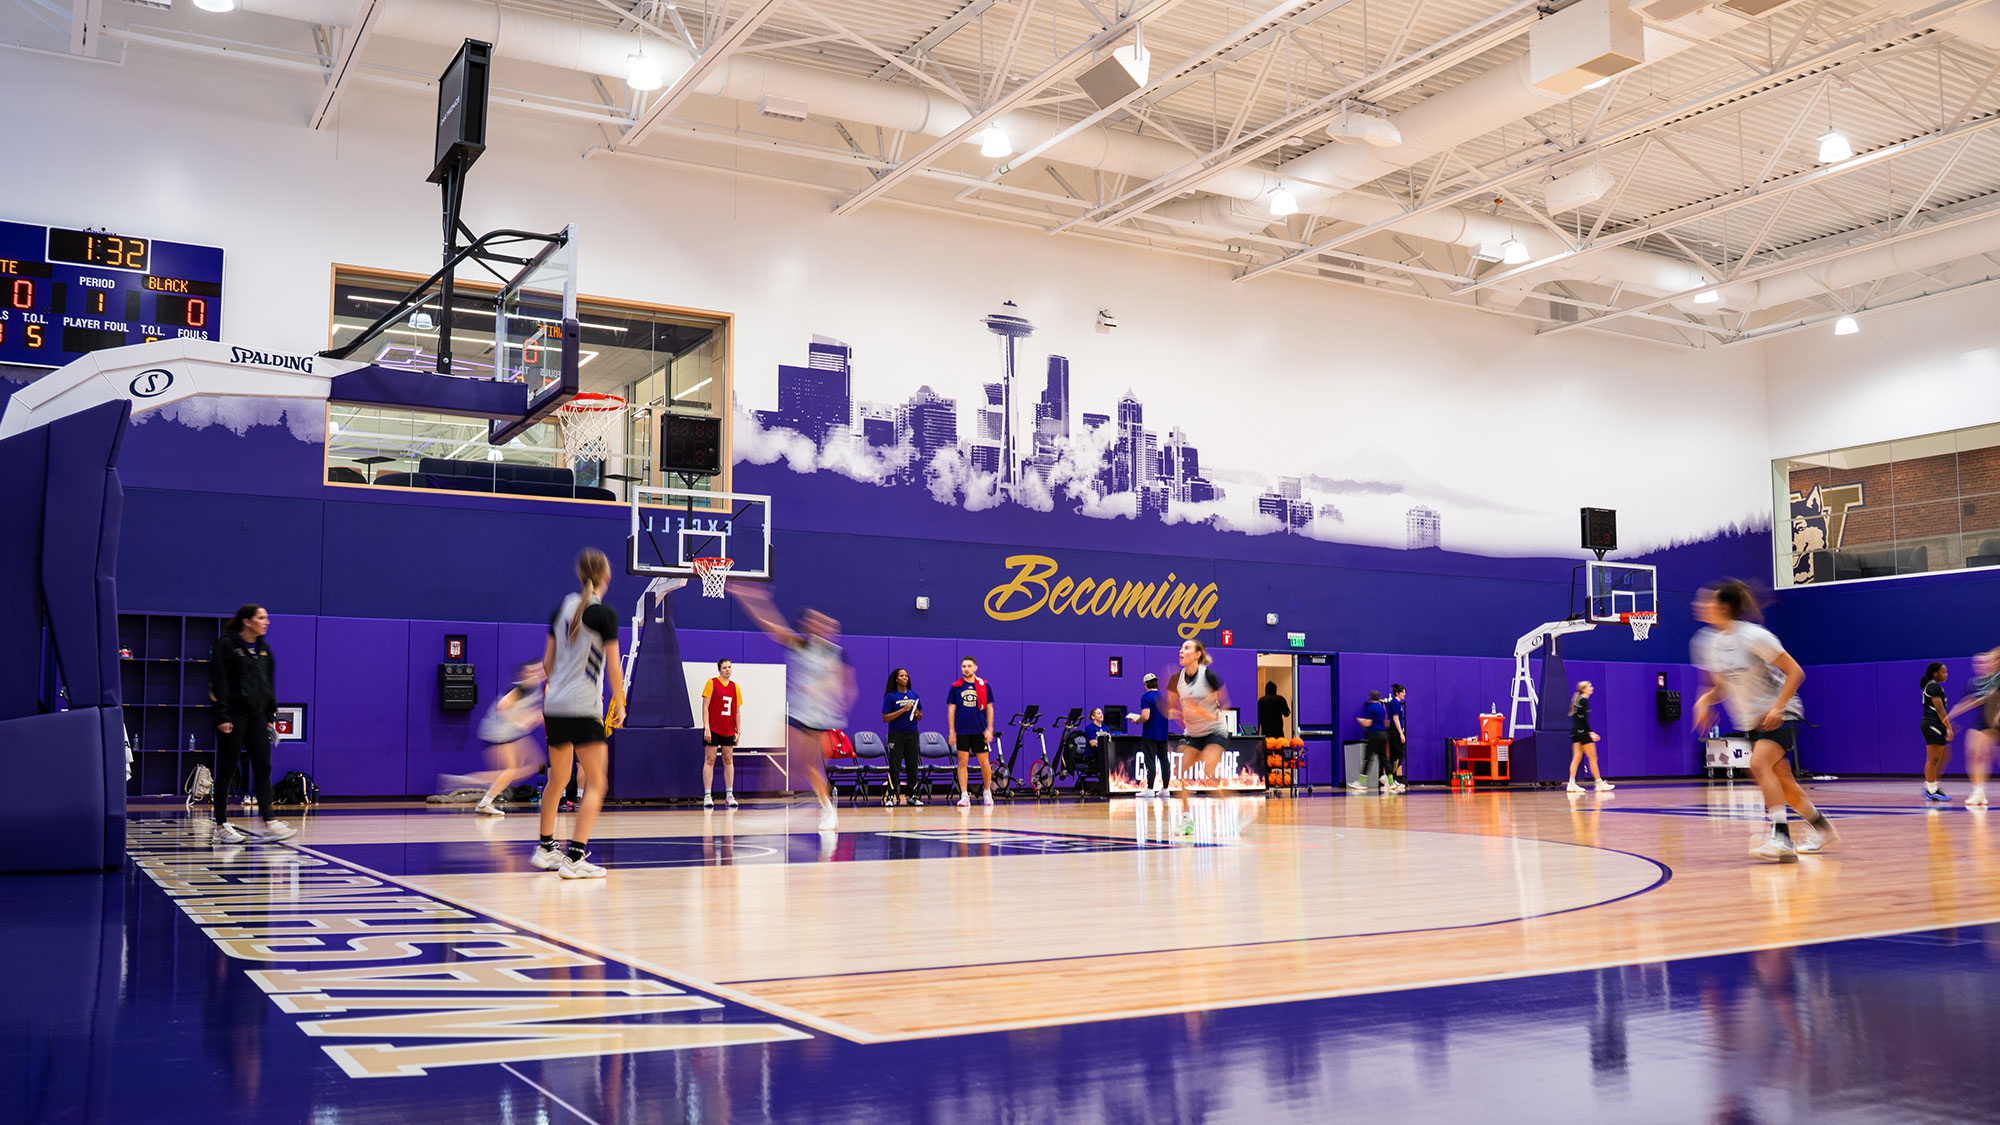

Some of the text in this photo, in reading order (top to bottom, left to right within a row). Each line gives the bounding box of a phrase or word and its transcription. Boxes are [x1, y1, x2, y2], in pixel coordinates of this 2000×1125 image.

[87, 236, 144, 268] 1:32
[79, 276, 115, 289] PERIOD
[148, 276, 188, 293] BLACK
[13, 279, 32, 308] 0
[98, 292, 104, 312] 1
[22, 312, 49, 324] T.O.L.
[187, 298, 205, 327] 0
[63, 316, 130, 332] PLAYER FOUL
[140, 324, 166, 336] T.O.L.
[27, 324, 42, 348] 5
[177, 328, 208, 341] FOULS
[230, 346, 313, 374] SPALDING
[984, 554, 1221, 640] Becoming
[721, 696, 732, 716] 3
[860, 732, 873, 742] W
[925, 732, 938, 742] W
